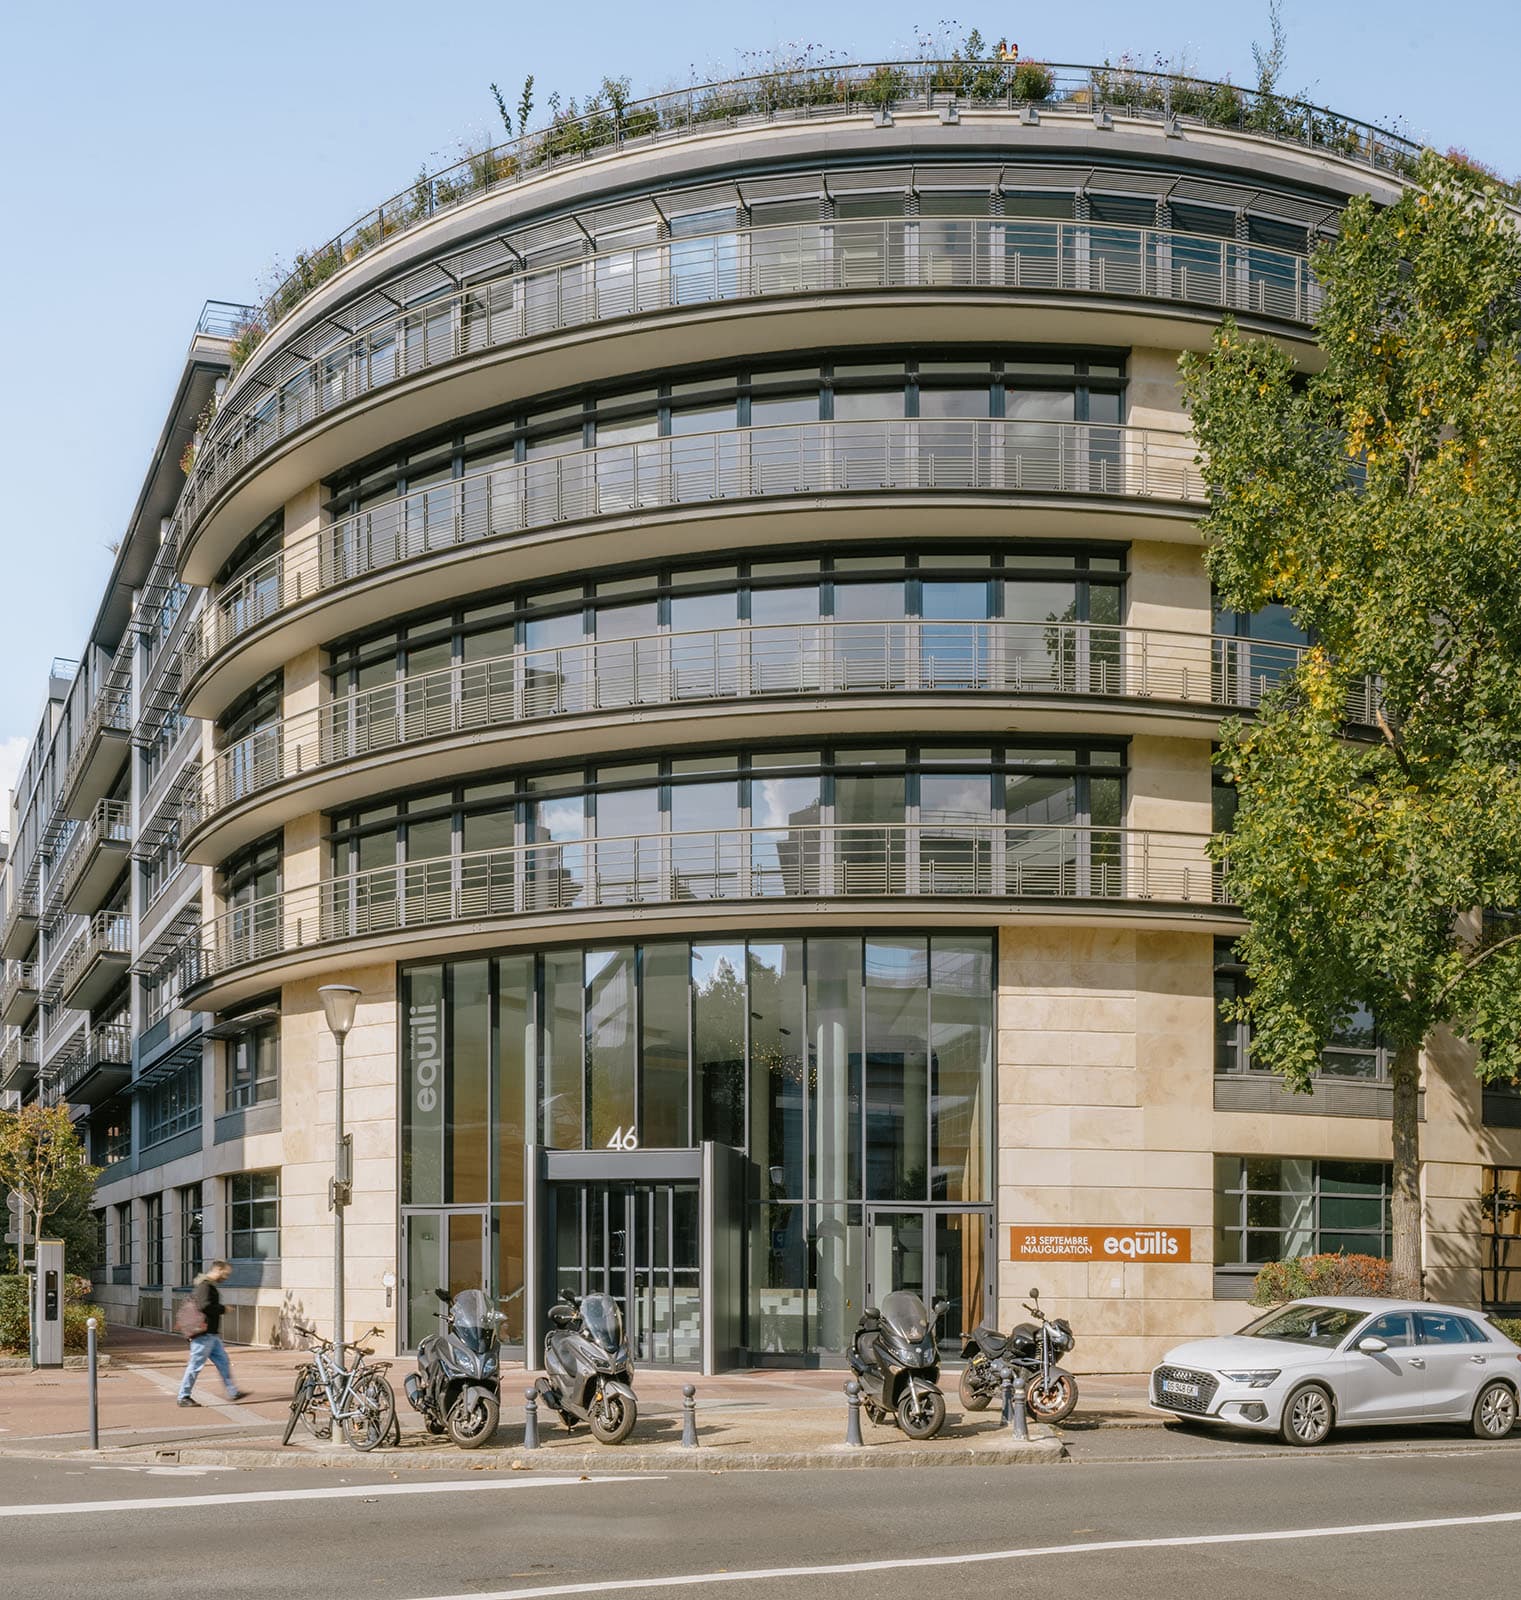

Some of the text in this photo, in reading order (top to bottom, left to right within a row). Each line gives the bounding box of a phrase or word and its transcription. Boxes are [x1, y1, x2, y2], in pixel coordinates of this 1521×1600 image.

[409, 986, 441, 1112] equili
[606, 1126, 639, 1150] 46
[1020, 1244, 1093, 1254] INAUGURATION
[1025, 1236, 1088, 1245] 23 SEPTEMBRE
